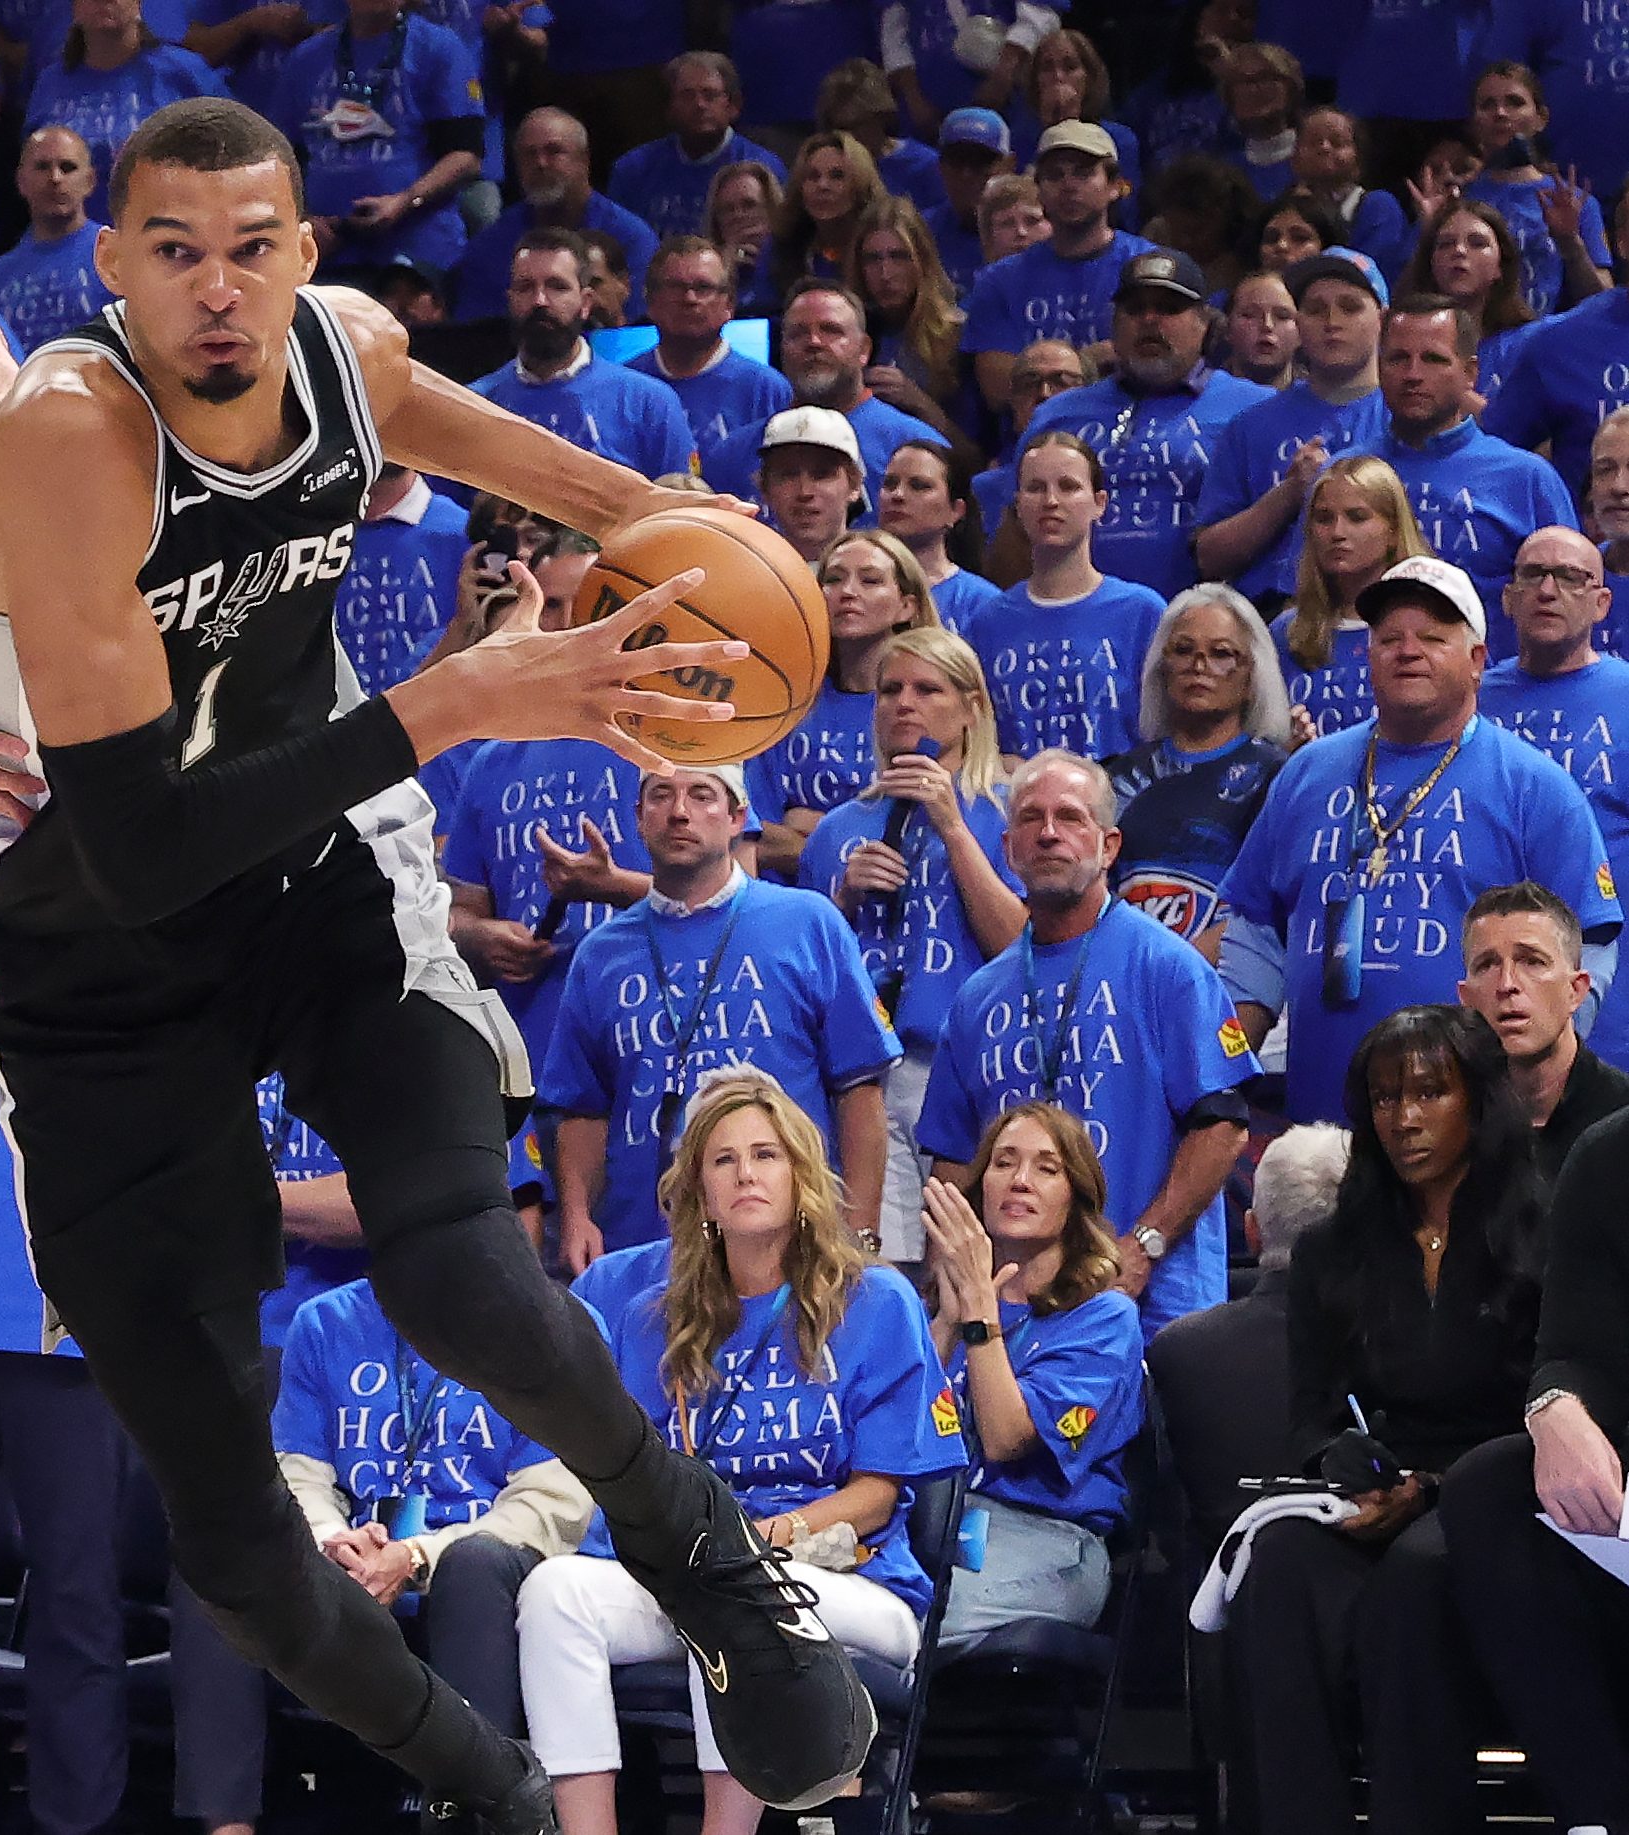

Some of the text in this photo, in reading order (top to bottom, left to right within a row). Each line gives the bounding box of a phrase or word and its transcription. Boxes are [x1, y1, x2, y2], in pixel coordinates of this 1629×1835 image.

[308, 460, 351, 493] LEDGER
[143, 522, 354, 651] SPURS
[993, 637, 1118, 680] OKLA
[180, 656, 232, 772] 1
[501, 766, 619, 815] OKLA
[1306, 917, 1449, 957] LUD
[618, 955, 765, 1008] OKLA
[985, 980, 1118, 1039] OKLA
[668, 1392, 843, 1450] HOMA
